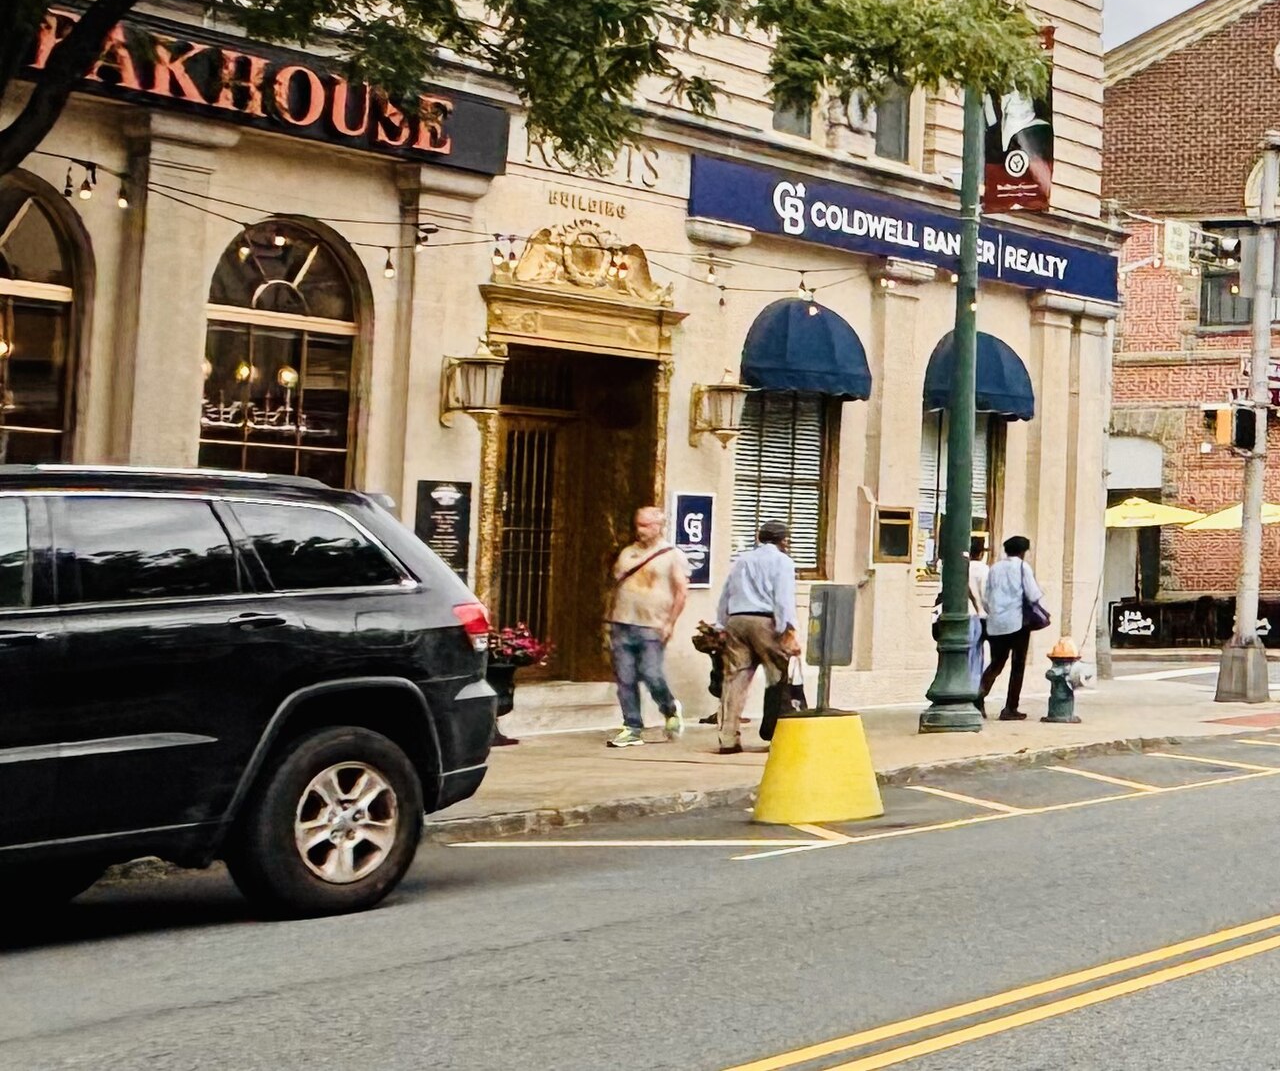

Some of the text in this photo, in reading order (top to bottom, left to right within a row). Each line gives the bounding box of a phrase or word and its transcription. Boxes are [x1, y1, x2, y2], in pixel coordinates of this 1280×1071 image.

[525, 127, 659, 188] RTS
[549, 190, 628, 220] BUILDING
[810, 201, 920, 248] COLDWELL
[923, 226, 995, 265] BANER
[1004, 245, 1067, 280] REALTY
